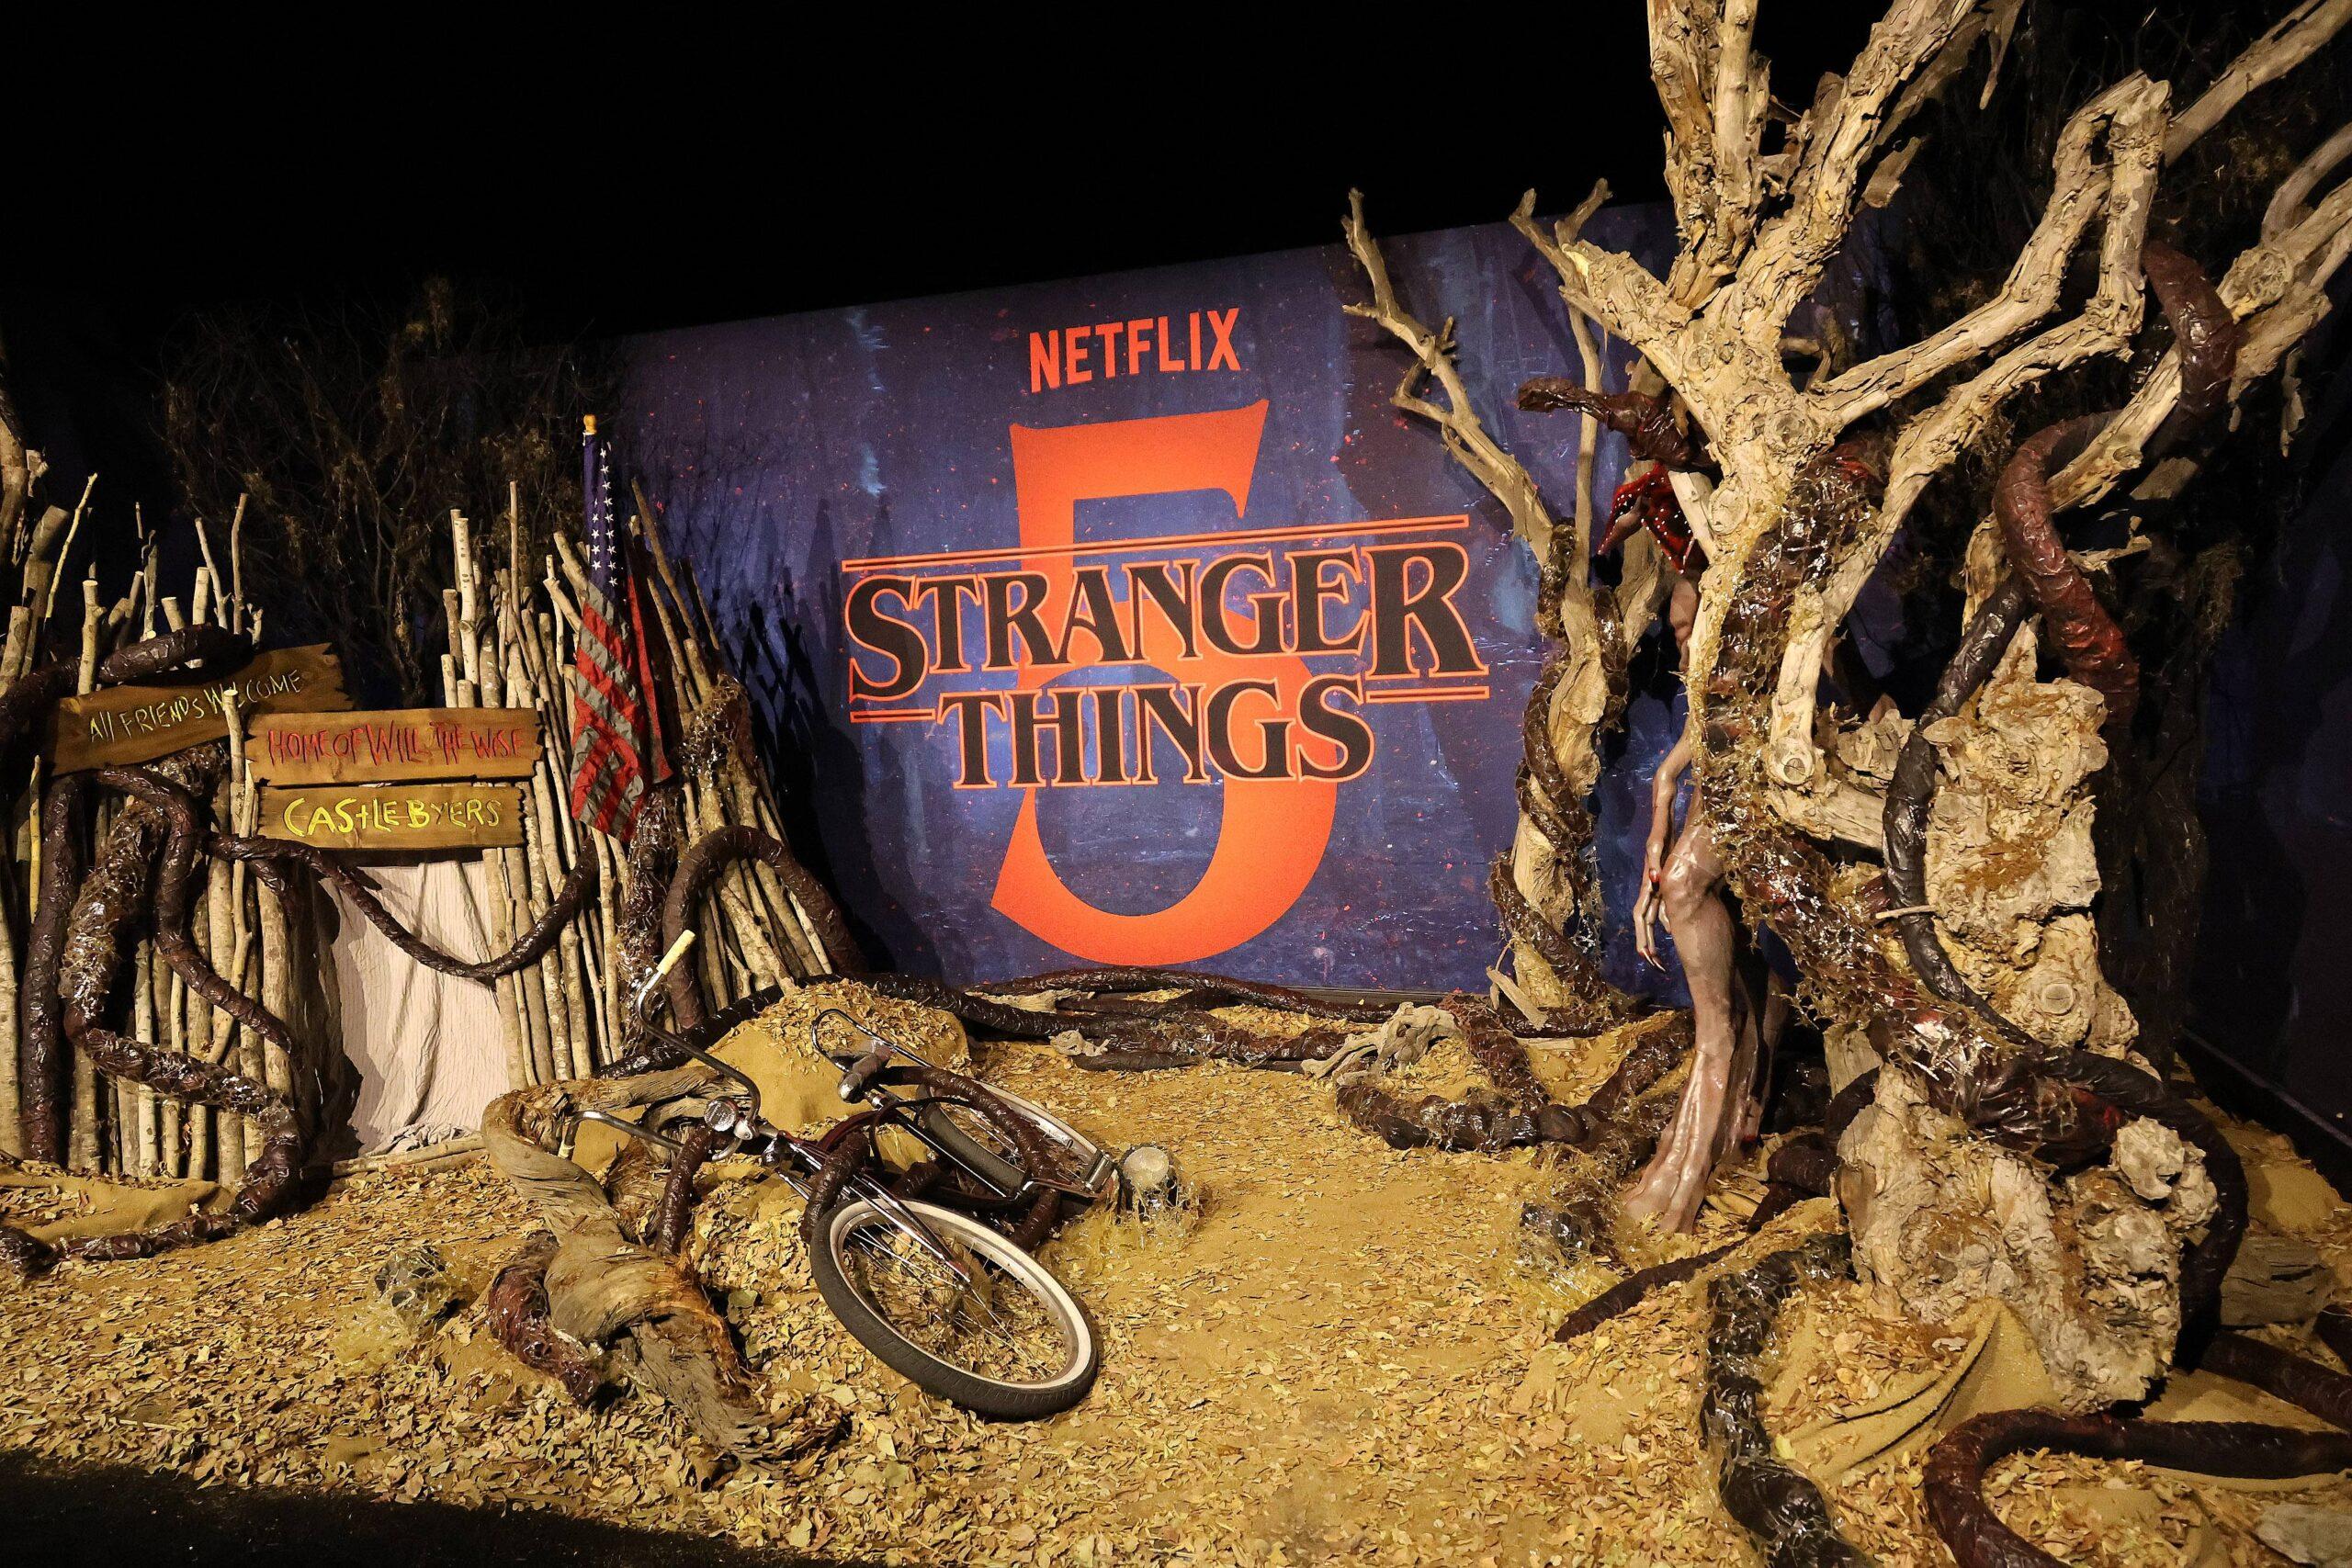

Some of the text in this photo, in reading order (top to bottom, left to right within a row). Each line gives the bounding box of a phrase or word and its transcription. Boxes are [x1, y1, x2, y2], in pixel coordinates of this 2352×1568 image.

[1028, 306, 1242, 393] NETFLIX
[843, 540, 1490, 703] STRANGER
[990, 398, 1338, 967] 5
[268, 728, 331, 766] HOME
[333, 727, 363, 764] OF
[365, 719, 433, 766] WILL
[935, 676, 1375, 791] THINGS
[405, 798, 502, 829] BYERS
